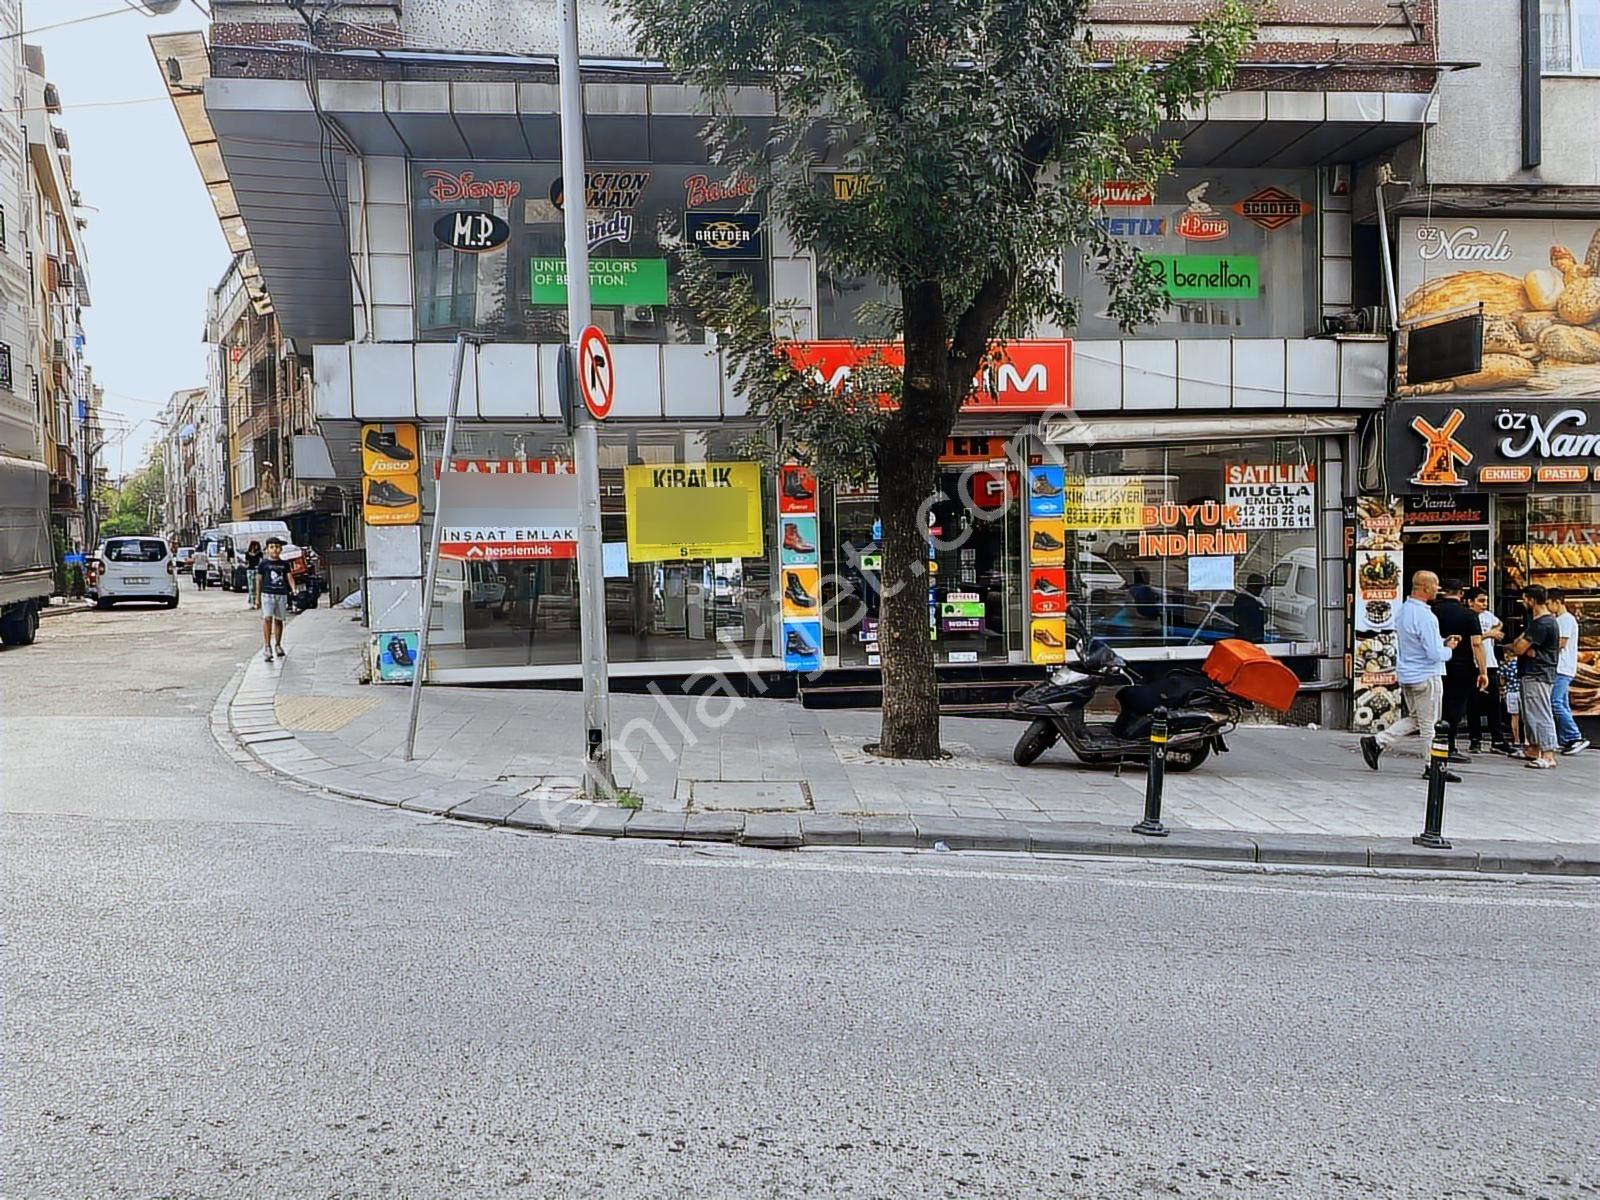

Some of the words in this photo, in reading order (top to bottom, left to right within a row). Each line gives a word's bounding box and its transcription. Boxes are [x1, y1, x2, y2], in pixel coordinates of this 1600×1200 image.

[423, 170, 521, 207] Disney
[1243, 202, 1301, 214] SCOOTER
[586, 210, 632, 243] indy
[1416, 224, 1438, 240] ÖZ
[695, 230, 750, 241] GREYDER
[534, 261, 567, 272] UNIT
[534, 275, 554, 285] OF
[1173, 259, 1251, 288] benetton
[1498, 408, 1526, 429] ÖZ
[1229, 465, 1309, 483] SATILIK
[1485, 469, 1525, 479] EKMEK
[1545, 468, 1580, 479] PASTA
[1245, 496, 1294, 506] EMLAK
[1141, 500, 1240, 527] BÜYÜK
[1258, 505, 1278, 516] 418
[1282, 505, 1294, 516] 22
[1297, 505, 1311, 516] 04
[1258, 517, 1278, 528] 470
[1282, 517, 1295, 527] 76
[1298, 516, 1310, 527] 11
[443, 529, 507, 543] İNŞAAT
[515, 529, 574, 541] EMLAK
[1138, 529, 1247, 556] İNDİRİM
[485, 544, 553, 557] hepsiemlak
